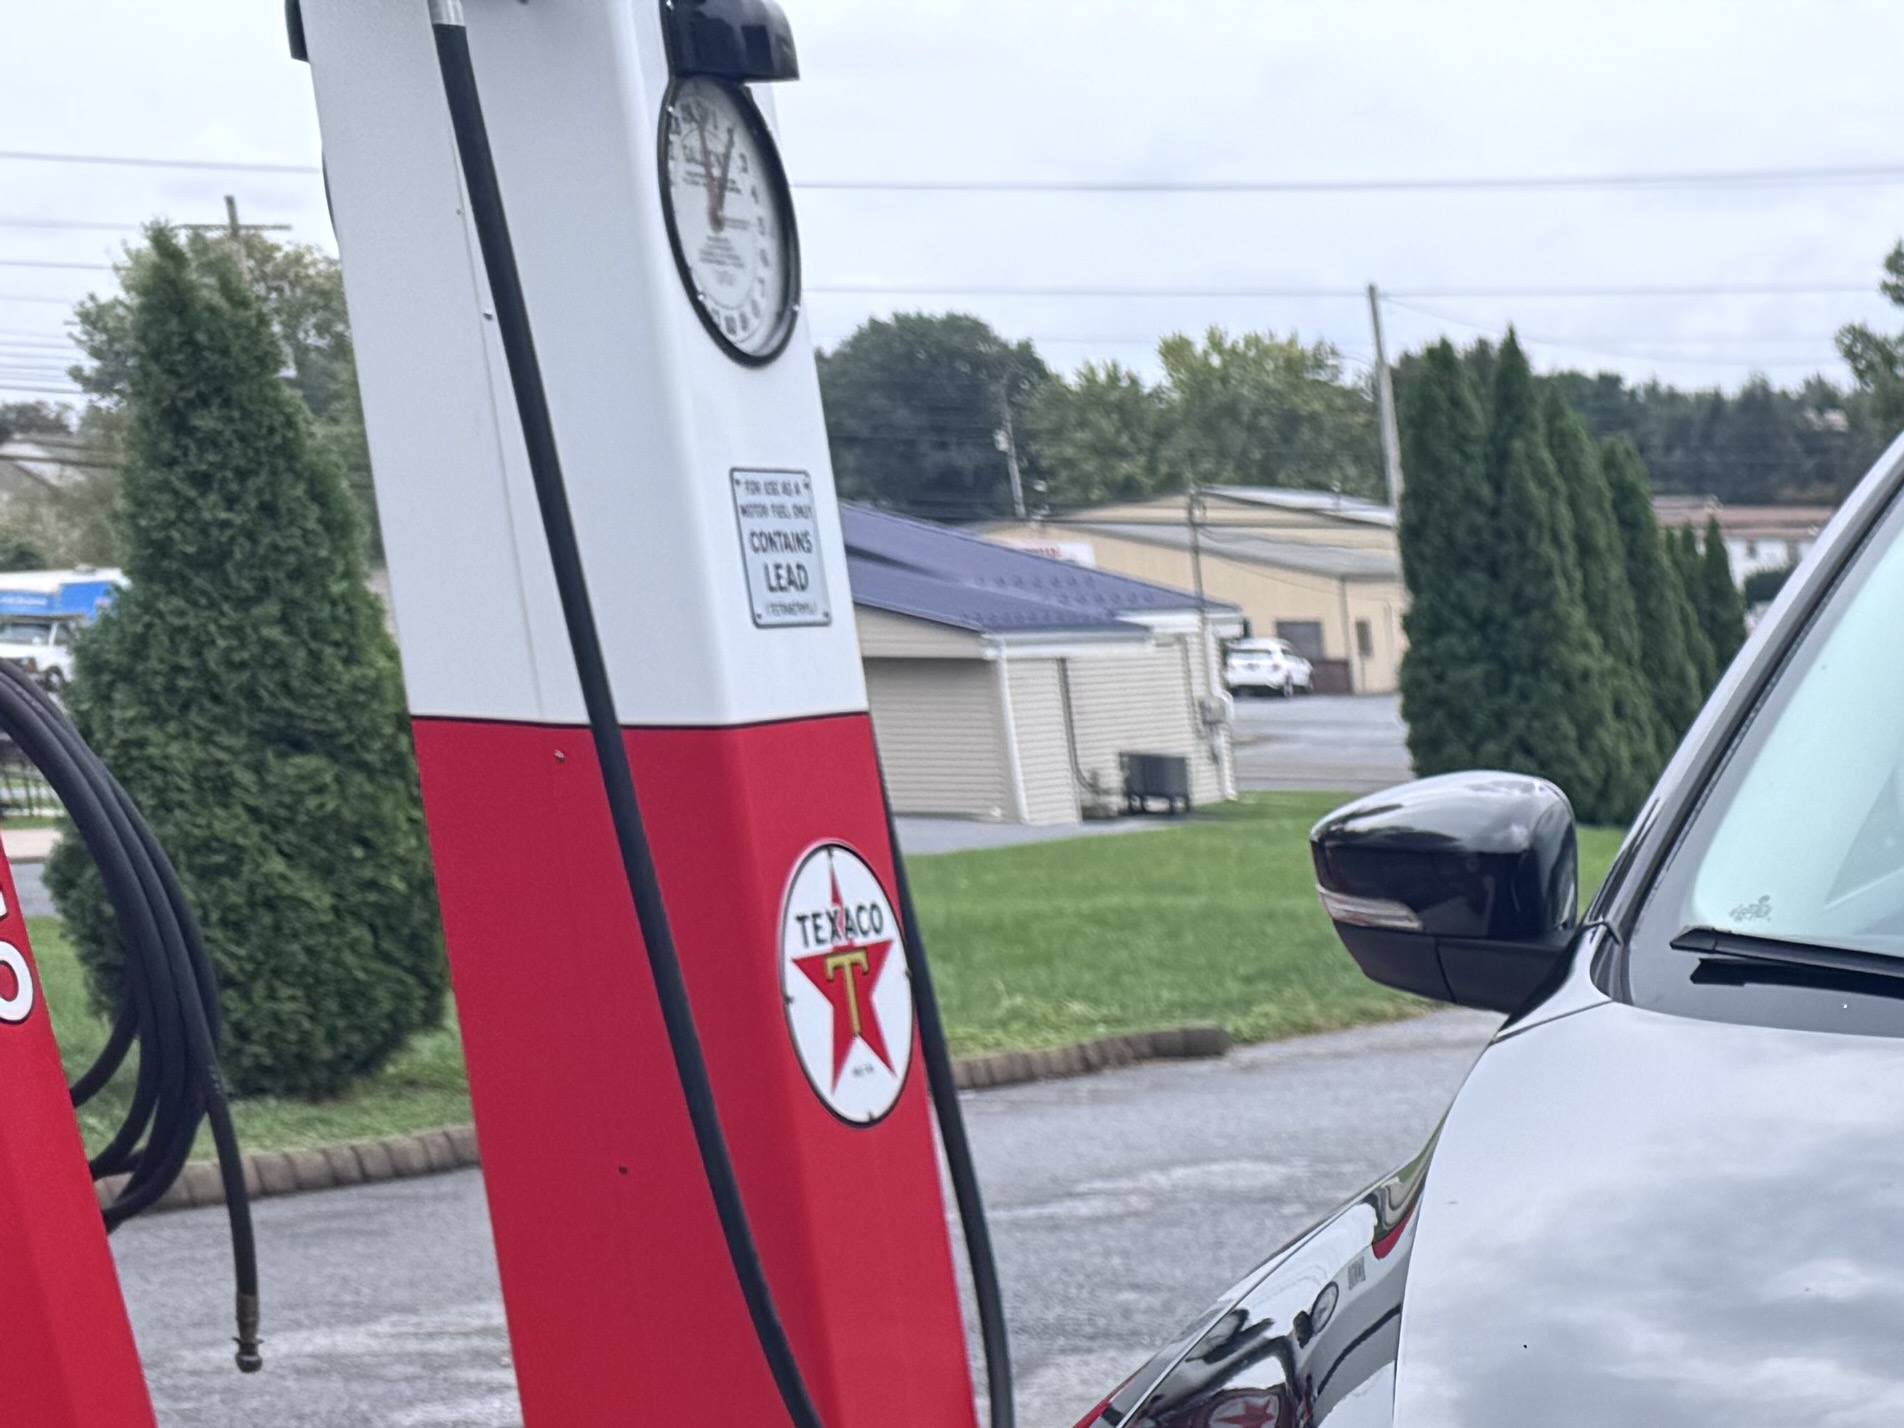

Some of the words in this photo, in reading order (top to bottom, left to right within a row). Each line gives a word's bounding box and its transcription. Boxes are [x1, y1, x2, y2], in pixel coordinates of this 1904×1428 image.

[740, 503, 769, 519] MOTOR
[771, 504, 792, 520] FUEL
[793, 504, 813, 520] ONLY
[749, 530, 814, 554] CONTAINS
[763, 562, 810, 593] LEAD
[795, 903, 884, 949] TEXACO
[825, 949, 870, 1037] T
